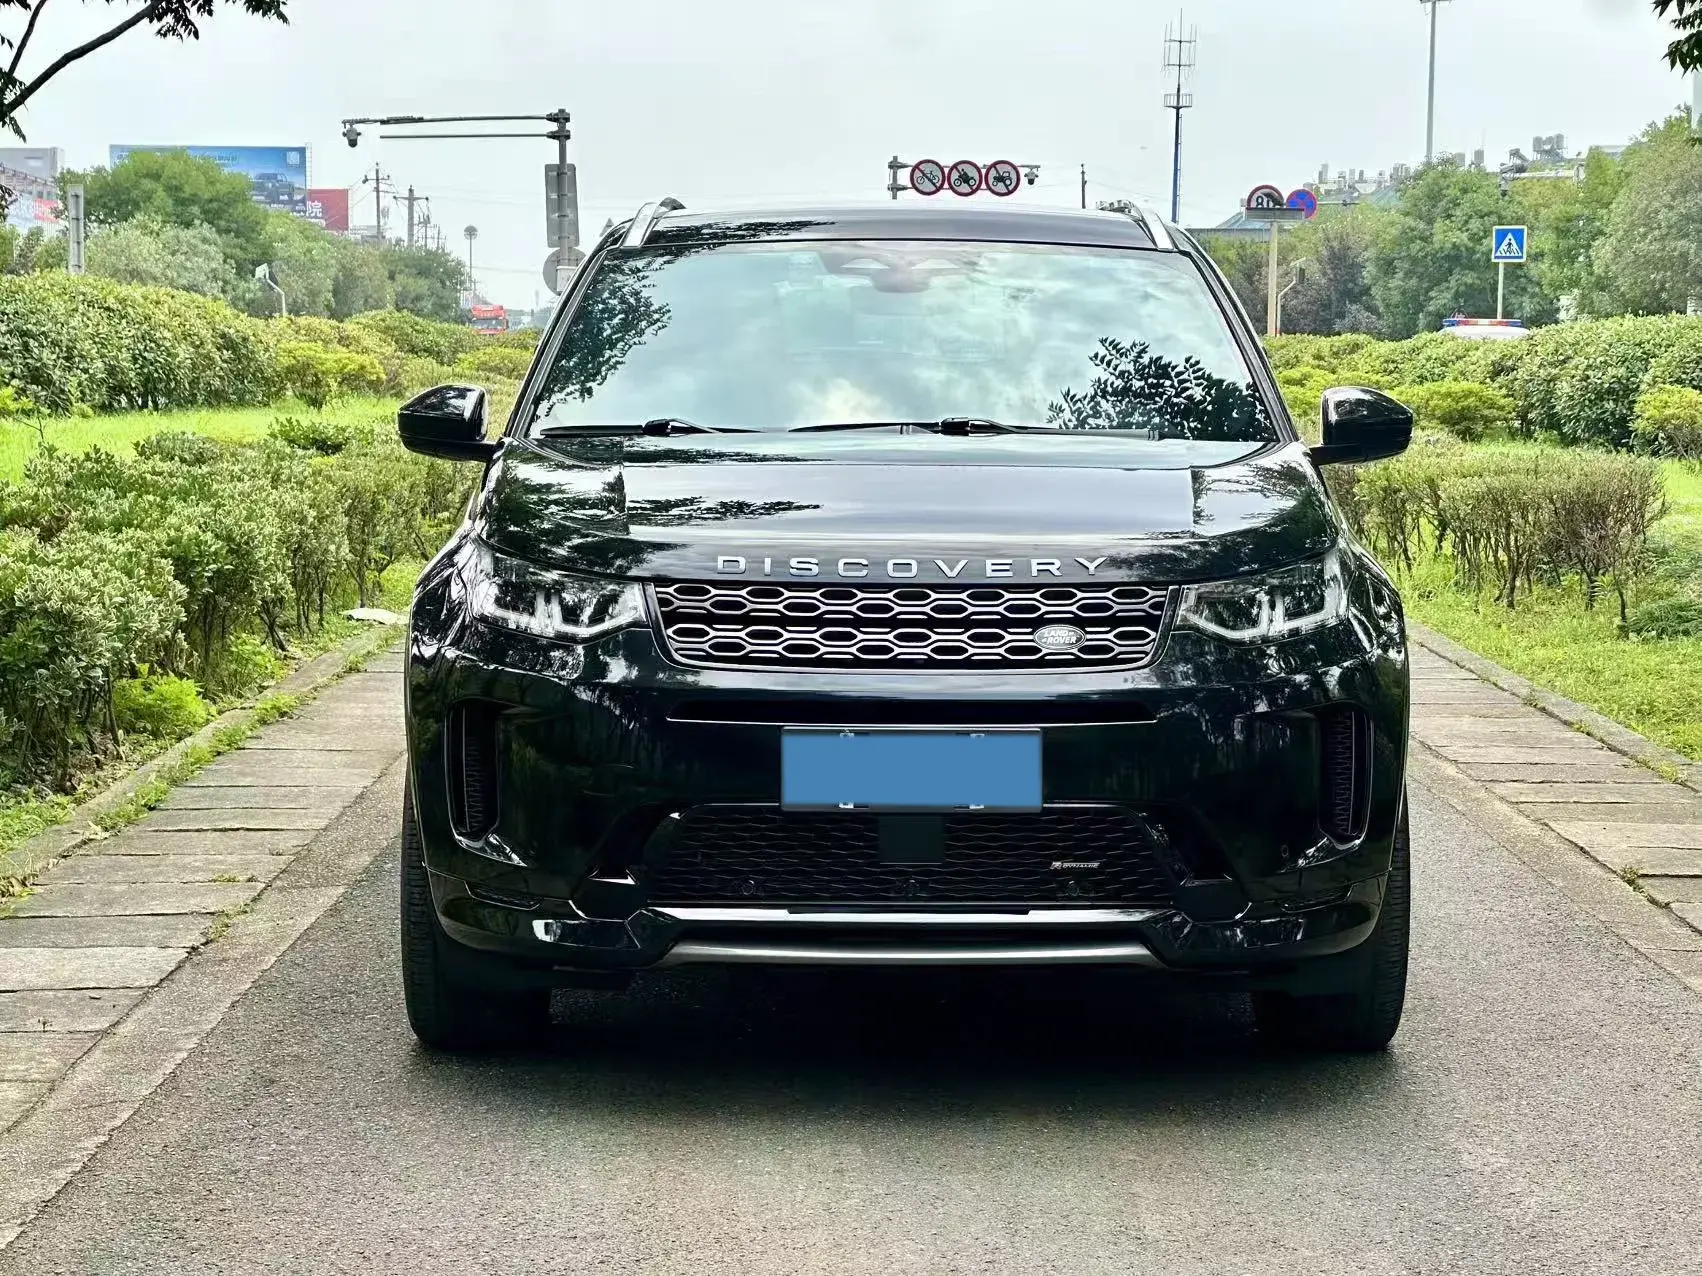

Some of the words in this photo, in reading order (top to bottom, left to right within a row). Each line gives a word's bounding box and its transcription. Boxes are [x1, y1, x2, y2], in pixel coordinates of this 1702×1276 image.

[717, 555, 1108, 577] DISCOVERY
[1043, 629, 1069, 637] LAND
[1046, 636, 1077, 644] ROVER
